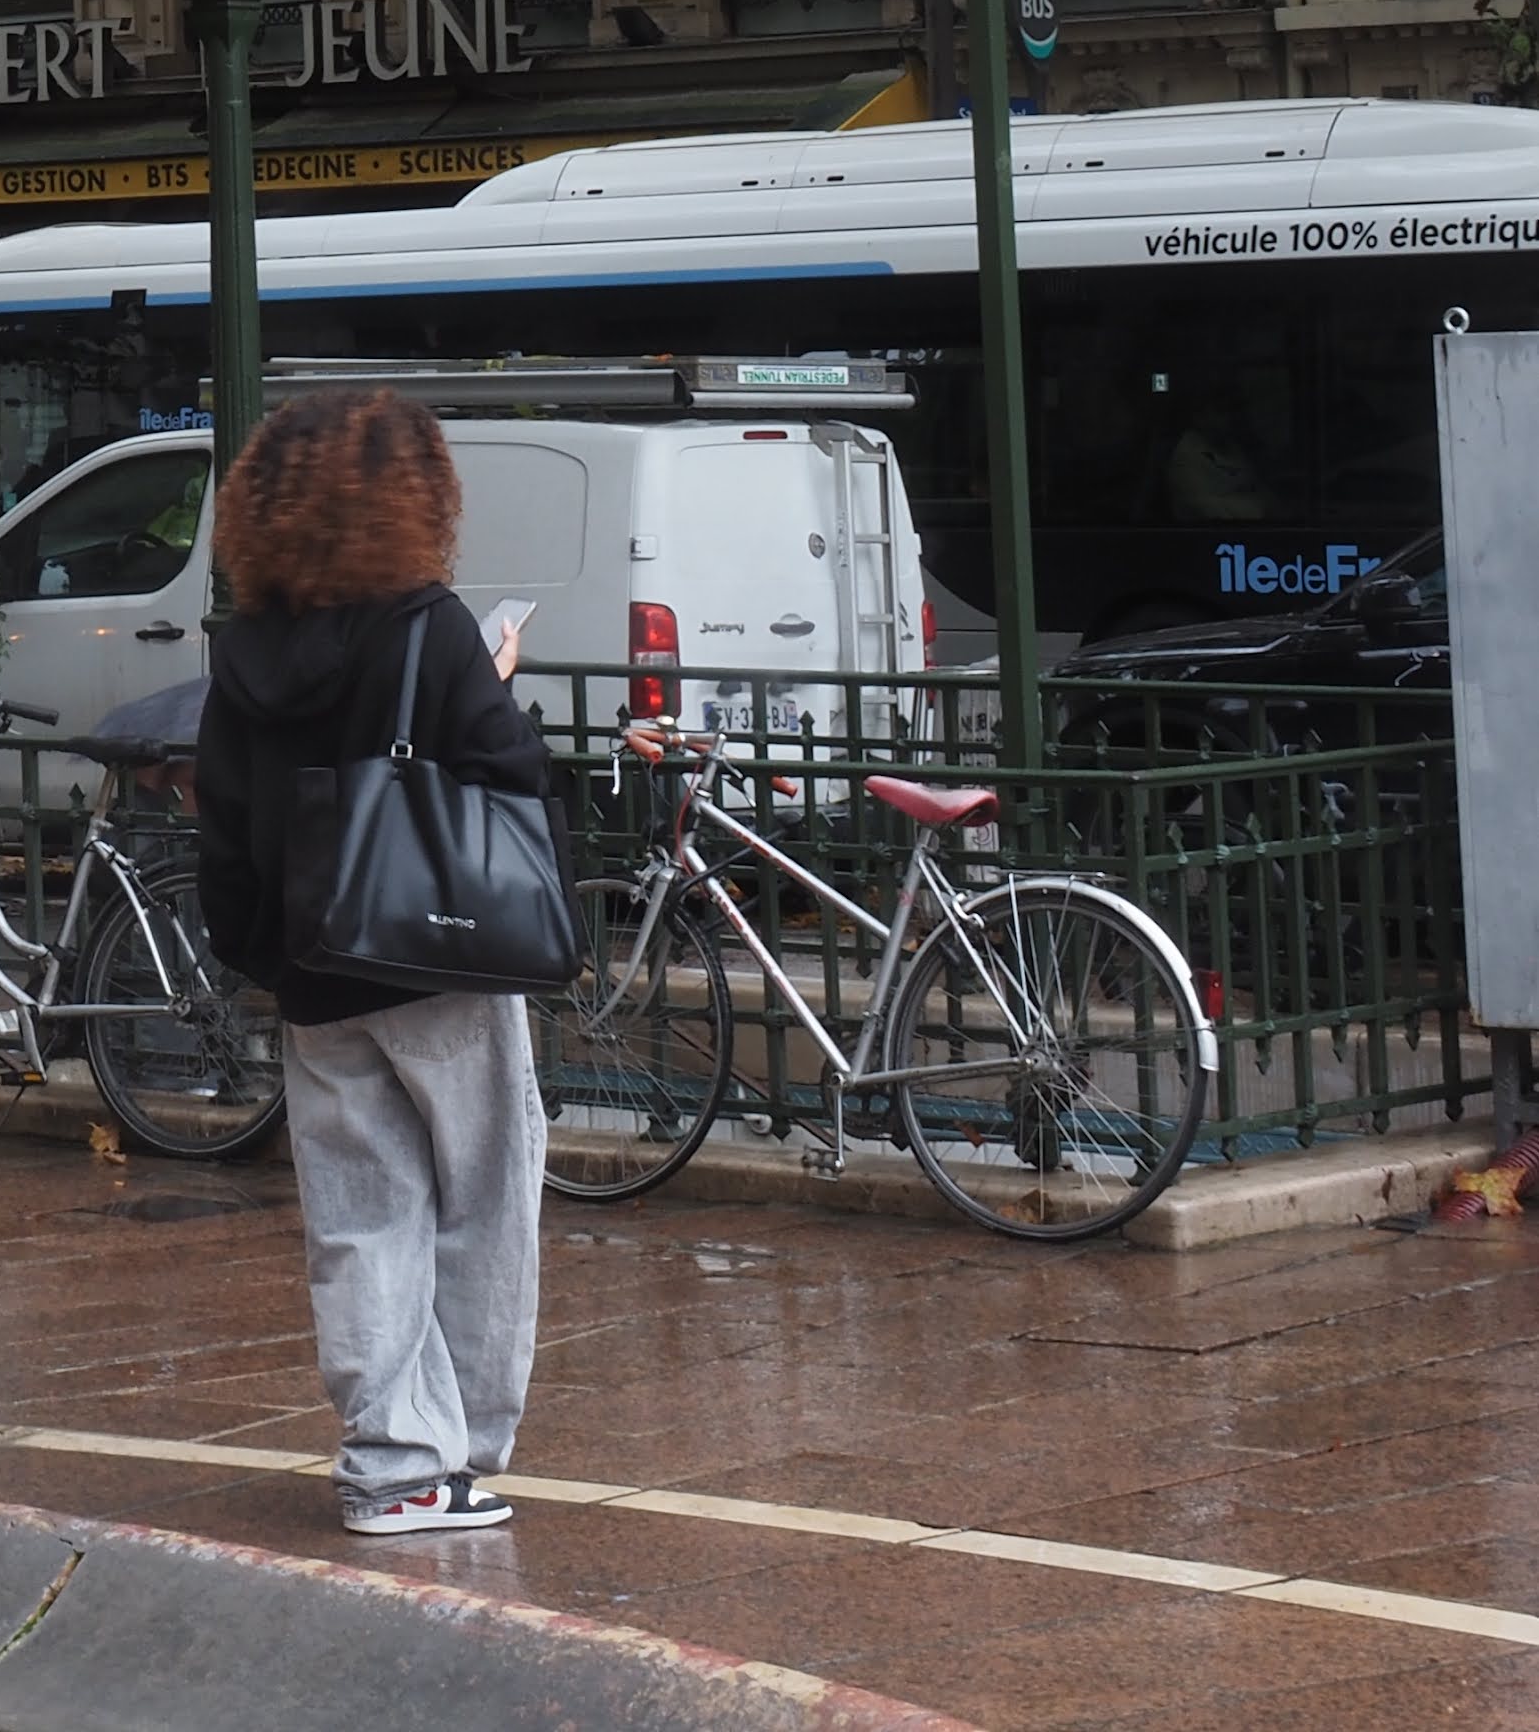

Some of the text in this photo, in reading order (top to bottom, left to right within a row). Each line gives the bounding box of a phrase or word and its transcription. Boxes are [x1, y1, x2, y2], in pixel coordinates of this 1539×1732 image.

[2, 169, 106, 195] GESTION
[146, 163, 189, 188] BTS
[253, 154, 357, 182] EDECINE
[399, 144, 525, 175] SCIENCES
[1145, 224, 1278, 257] véhicule
[1288, 219, 1378, 252] 100%
[742, 370, 782, 384] TUNNEL
[785, 370, 845, 384] PEDESTRIAN
[715, 706, 788, 731] V-3-BJ
